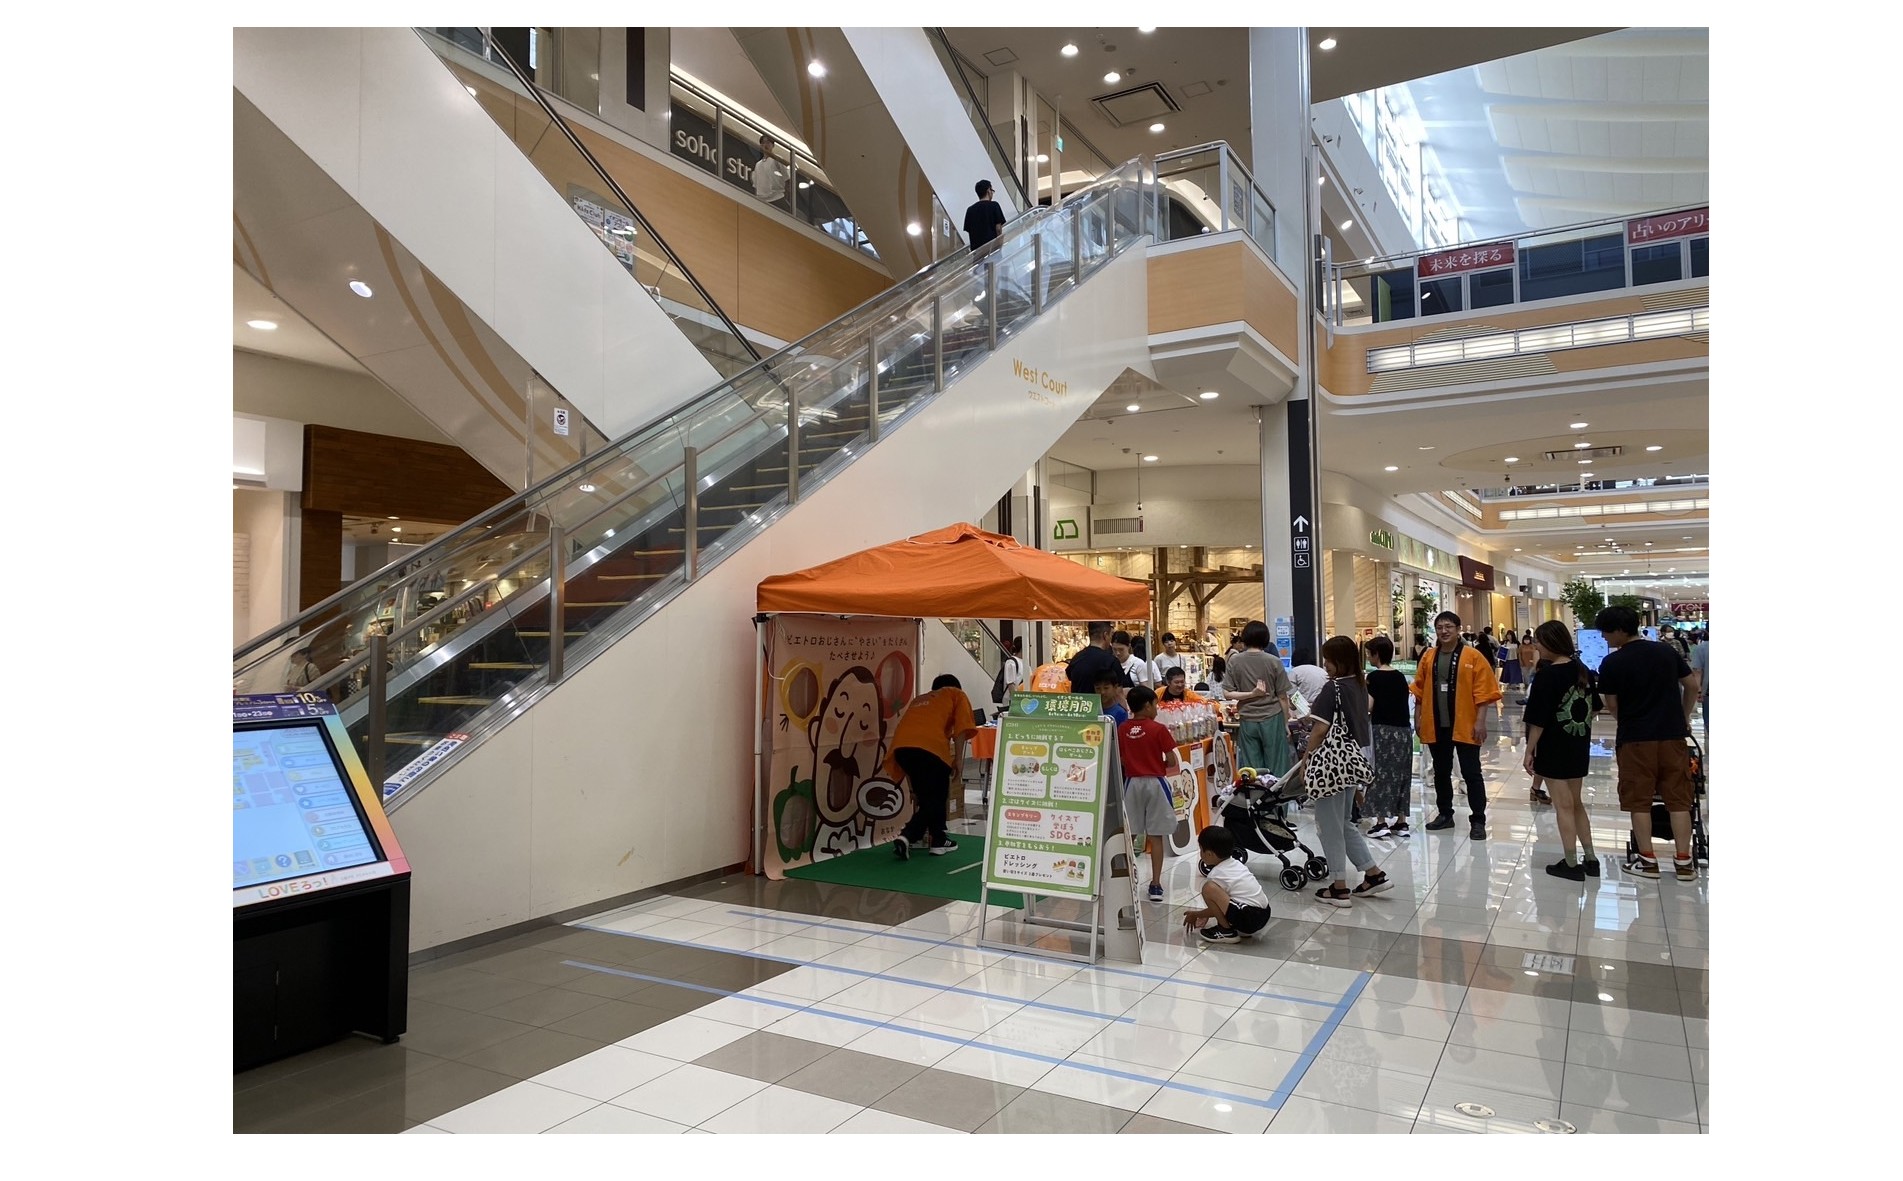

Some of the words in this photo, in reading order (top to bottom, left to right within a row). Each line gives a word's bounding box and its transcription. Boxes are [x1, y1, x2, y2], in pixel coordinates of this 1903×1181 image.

[726, 157, 752, 181] str
[1430, 248, 1502, 273] 未来を探る
[1013, 358, 1038, 384] West
[1041, 371, 1067, 397] Court
[1044, 699, 1093, 714] 環境月間
[1051, 813, 1080, 823] クイズで
[1053, 823, 1074, 831] 学ぼう
[1050, 830, 1076, 840] SDGs
[1004, 853, 1026, 861] ピエトロ
[1003, 860, 1037, 869] ドレッシング
